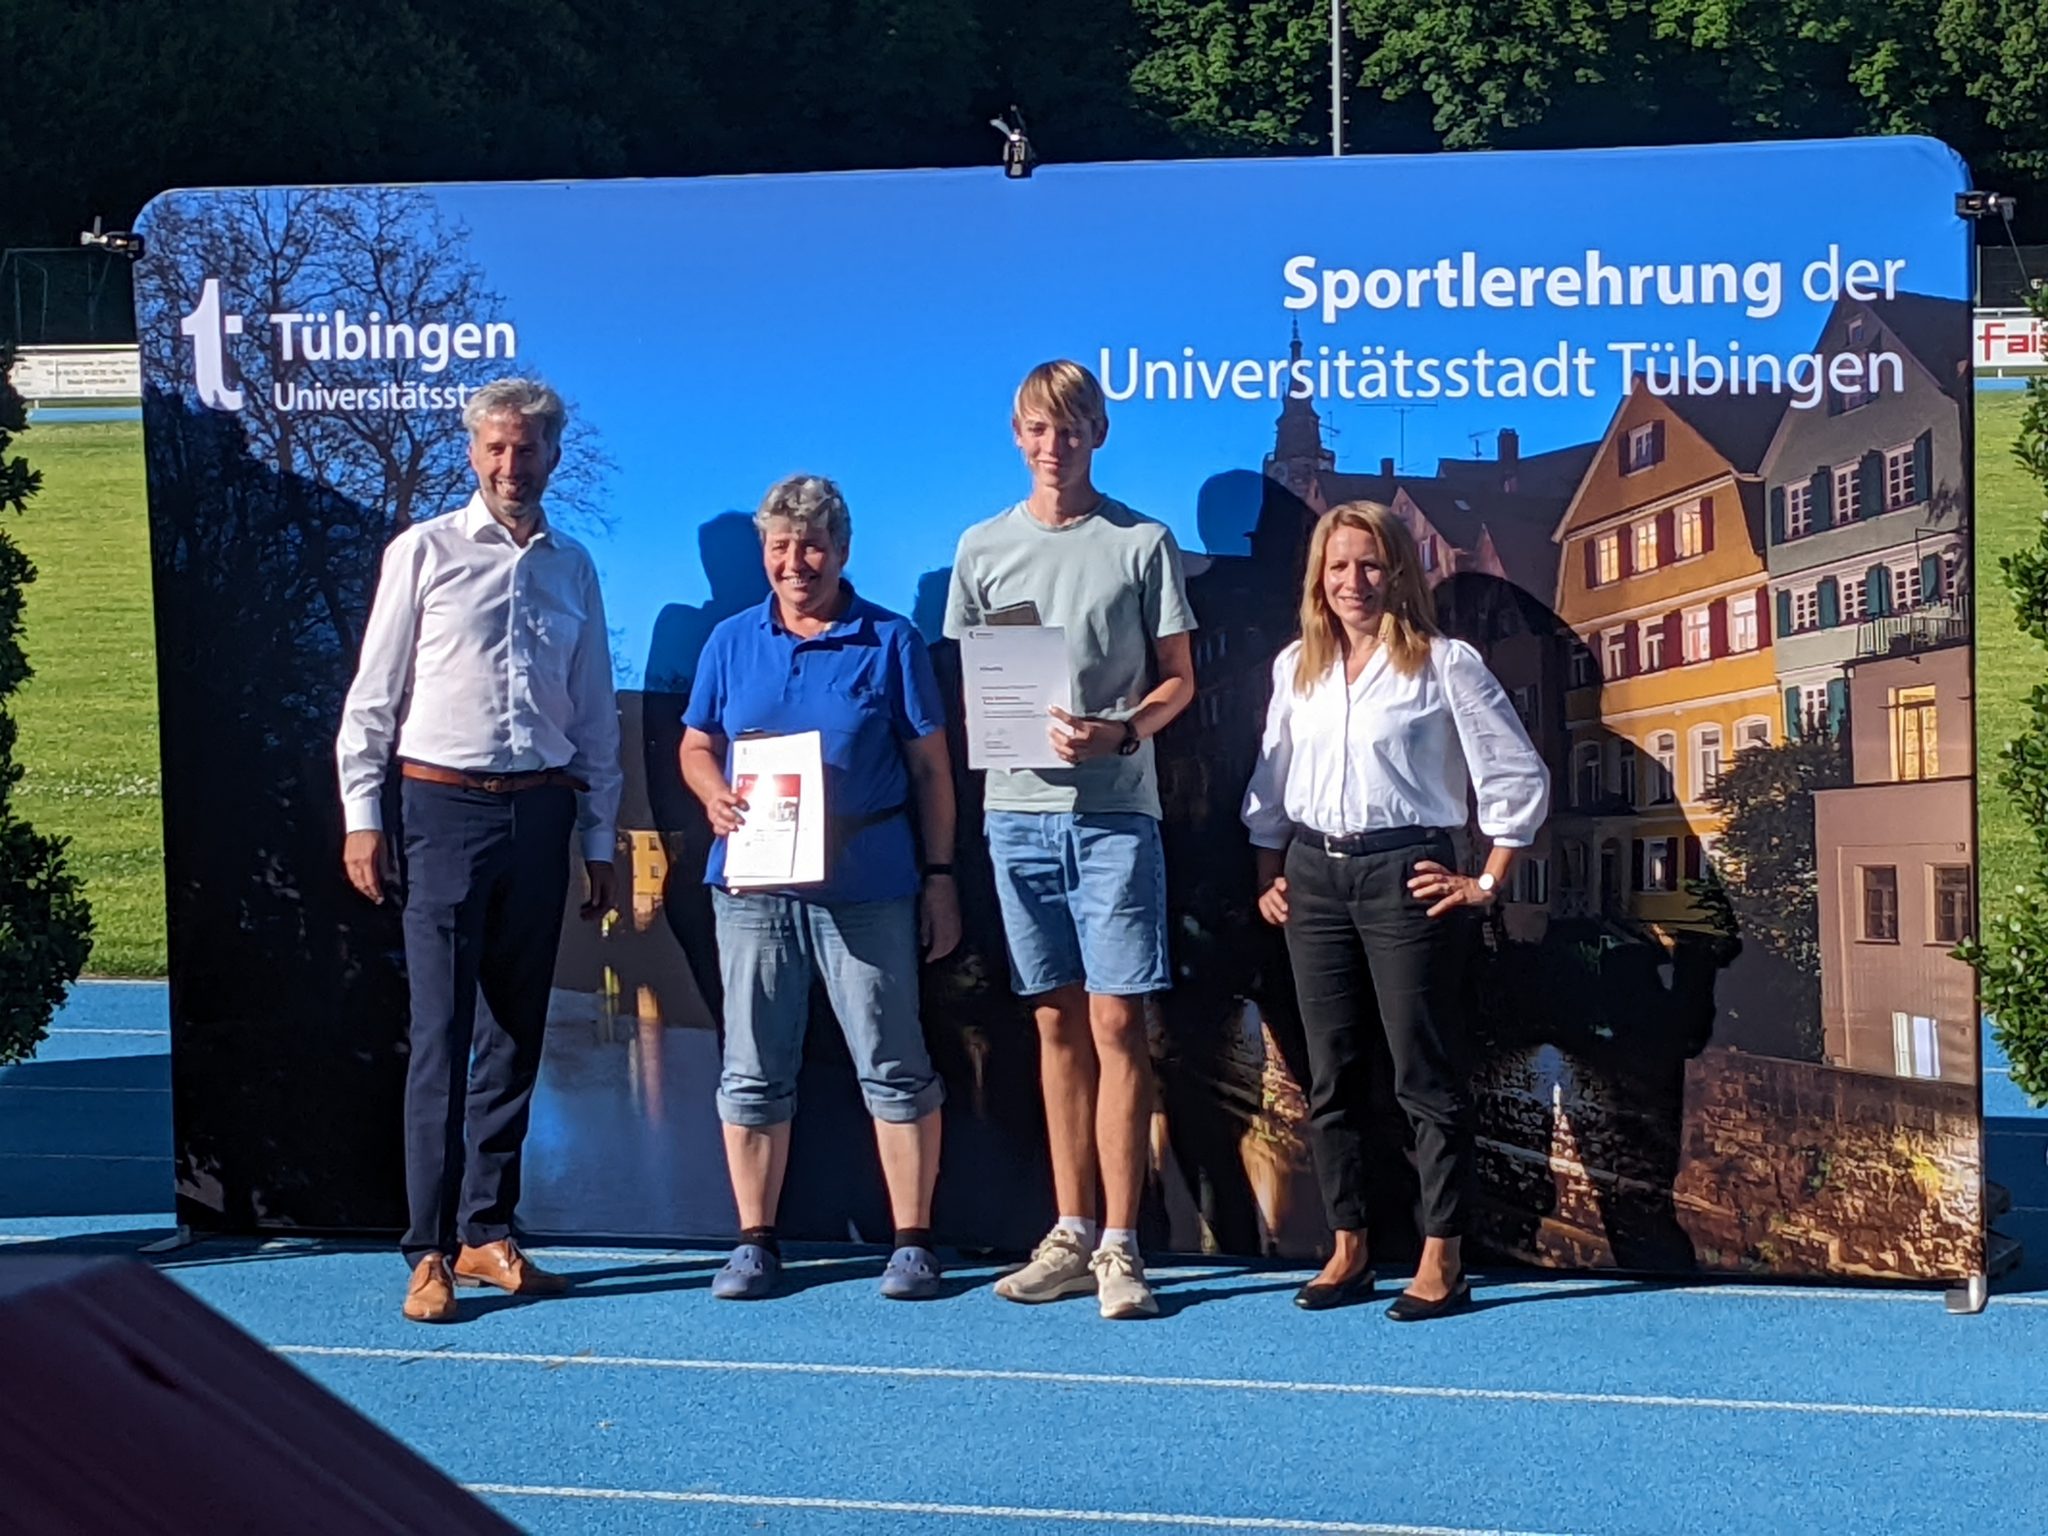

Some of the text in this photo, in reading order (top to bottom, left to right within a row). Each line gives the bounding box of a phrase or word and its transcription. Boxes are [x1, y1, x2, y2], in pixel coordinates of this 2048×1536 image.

[1283, 244, 1905, 320] Sportlerehrung der
[270, 310, 516, 372] Tübingen
[274, 382, 482, 411] Universitätsst
[1100, 340, 1905, 409] Universitätsstadt Tübingen
